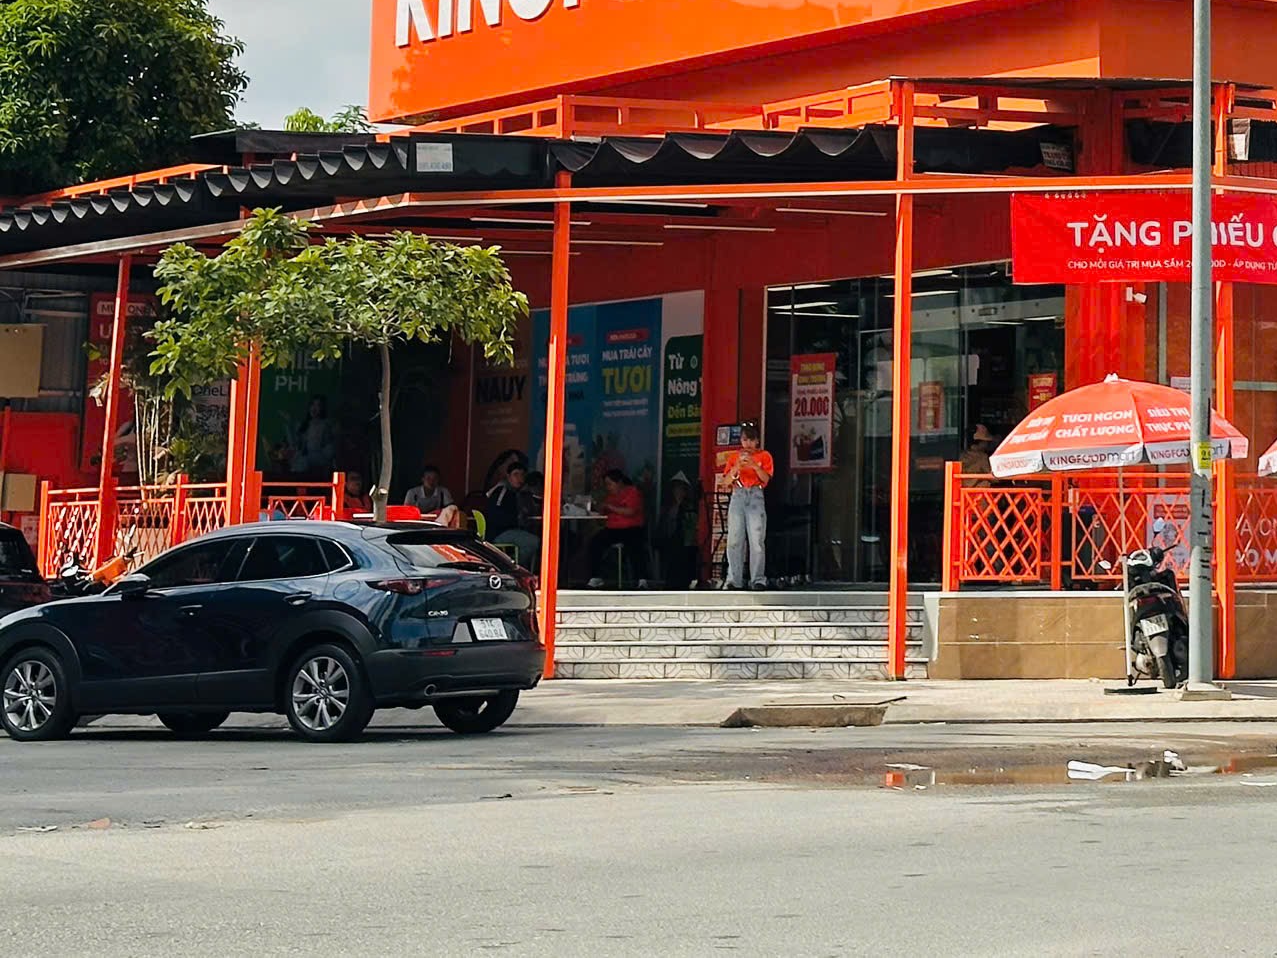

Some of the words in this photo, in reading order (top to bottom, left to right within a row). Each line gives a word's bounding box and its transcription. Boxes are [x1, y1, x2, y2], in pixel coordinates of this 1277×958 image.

[1066, 213, 1161, 254] TẶNG
[1141, 260, 1162, 269] MUA
[668, 377, 698, 398] Nông
[1094, 410, 1133, 422] NGON
[1055, 425, 1088, 438] CHẤT
